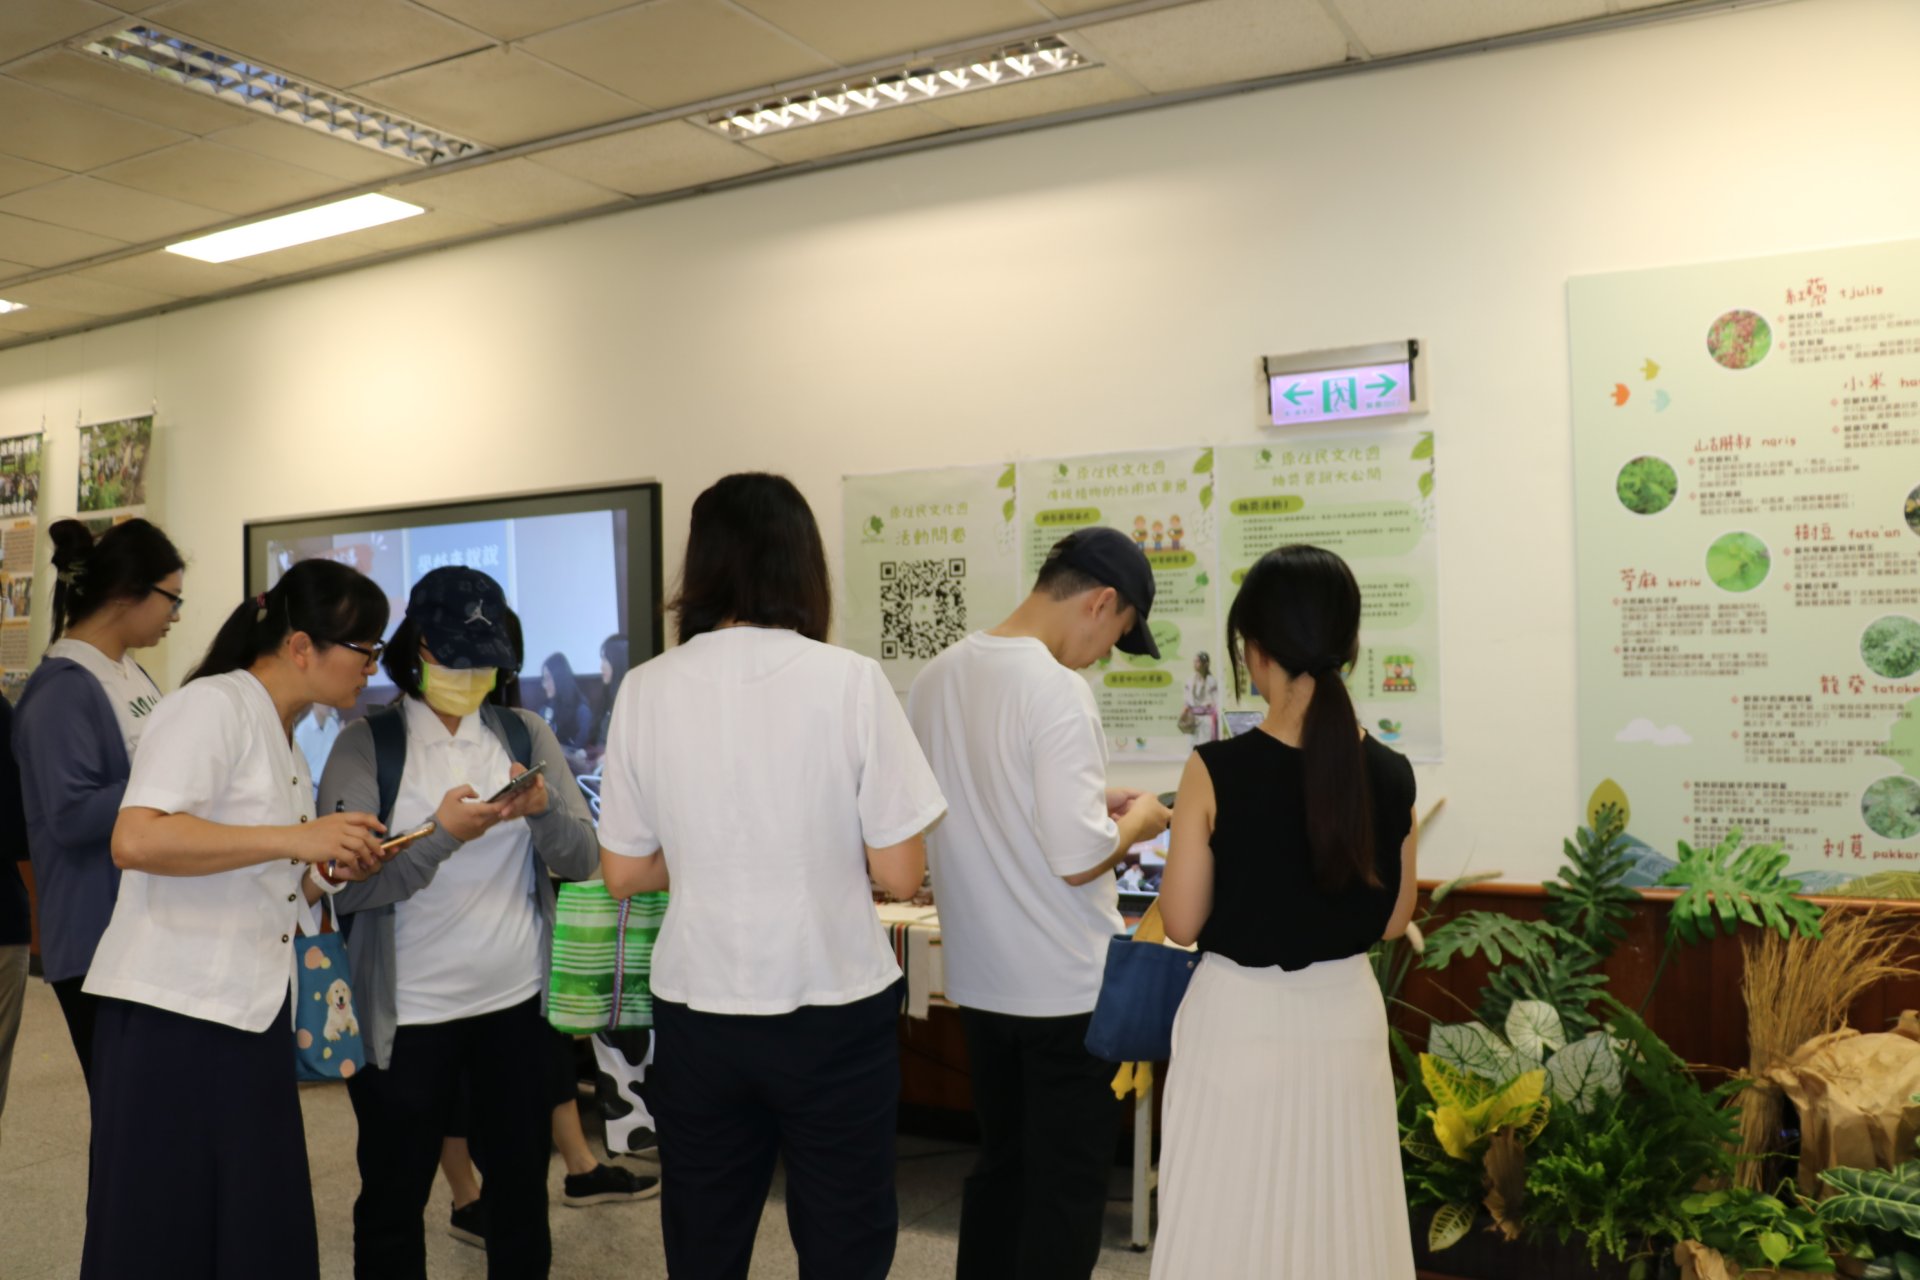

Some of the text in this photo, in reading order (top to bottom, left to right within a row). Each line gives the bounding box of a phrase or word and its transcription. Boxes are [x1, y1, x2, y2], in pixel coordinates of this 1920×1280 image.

[1843, 371, 1887, 392] 小米
[1694, 433, 1752, 452] 山胡椒
[1795, 522, 1835, 541] 樹豆
[1620, 568, 1658, 592] 苧麻
[1820, 674, 1866, 695] 龍葵
[1823, 834, 1867, 859] 刺莧
